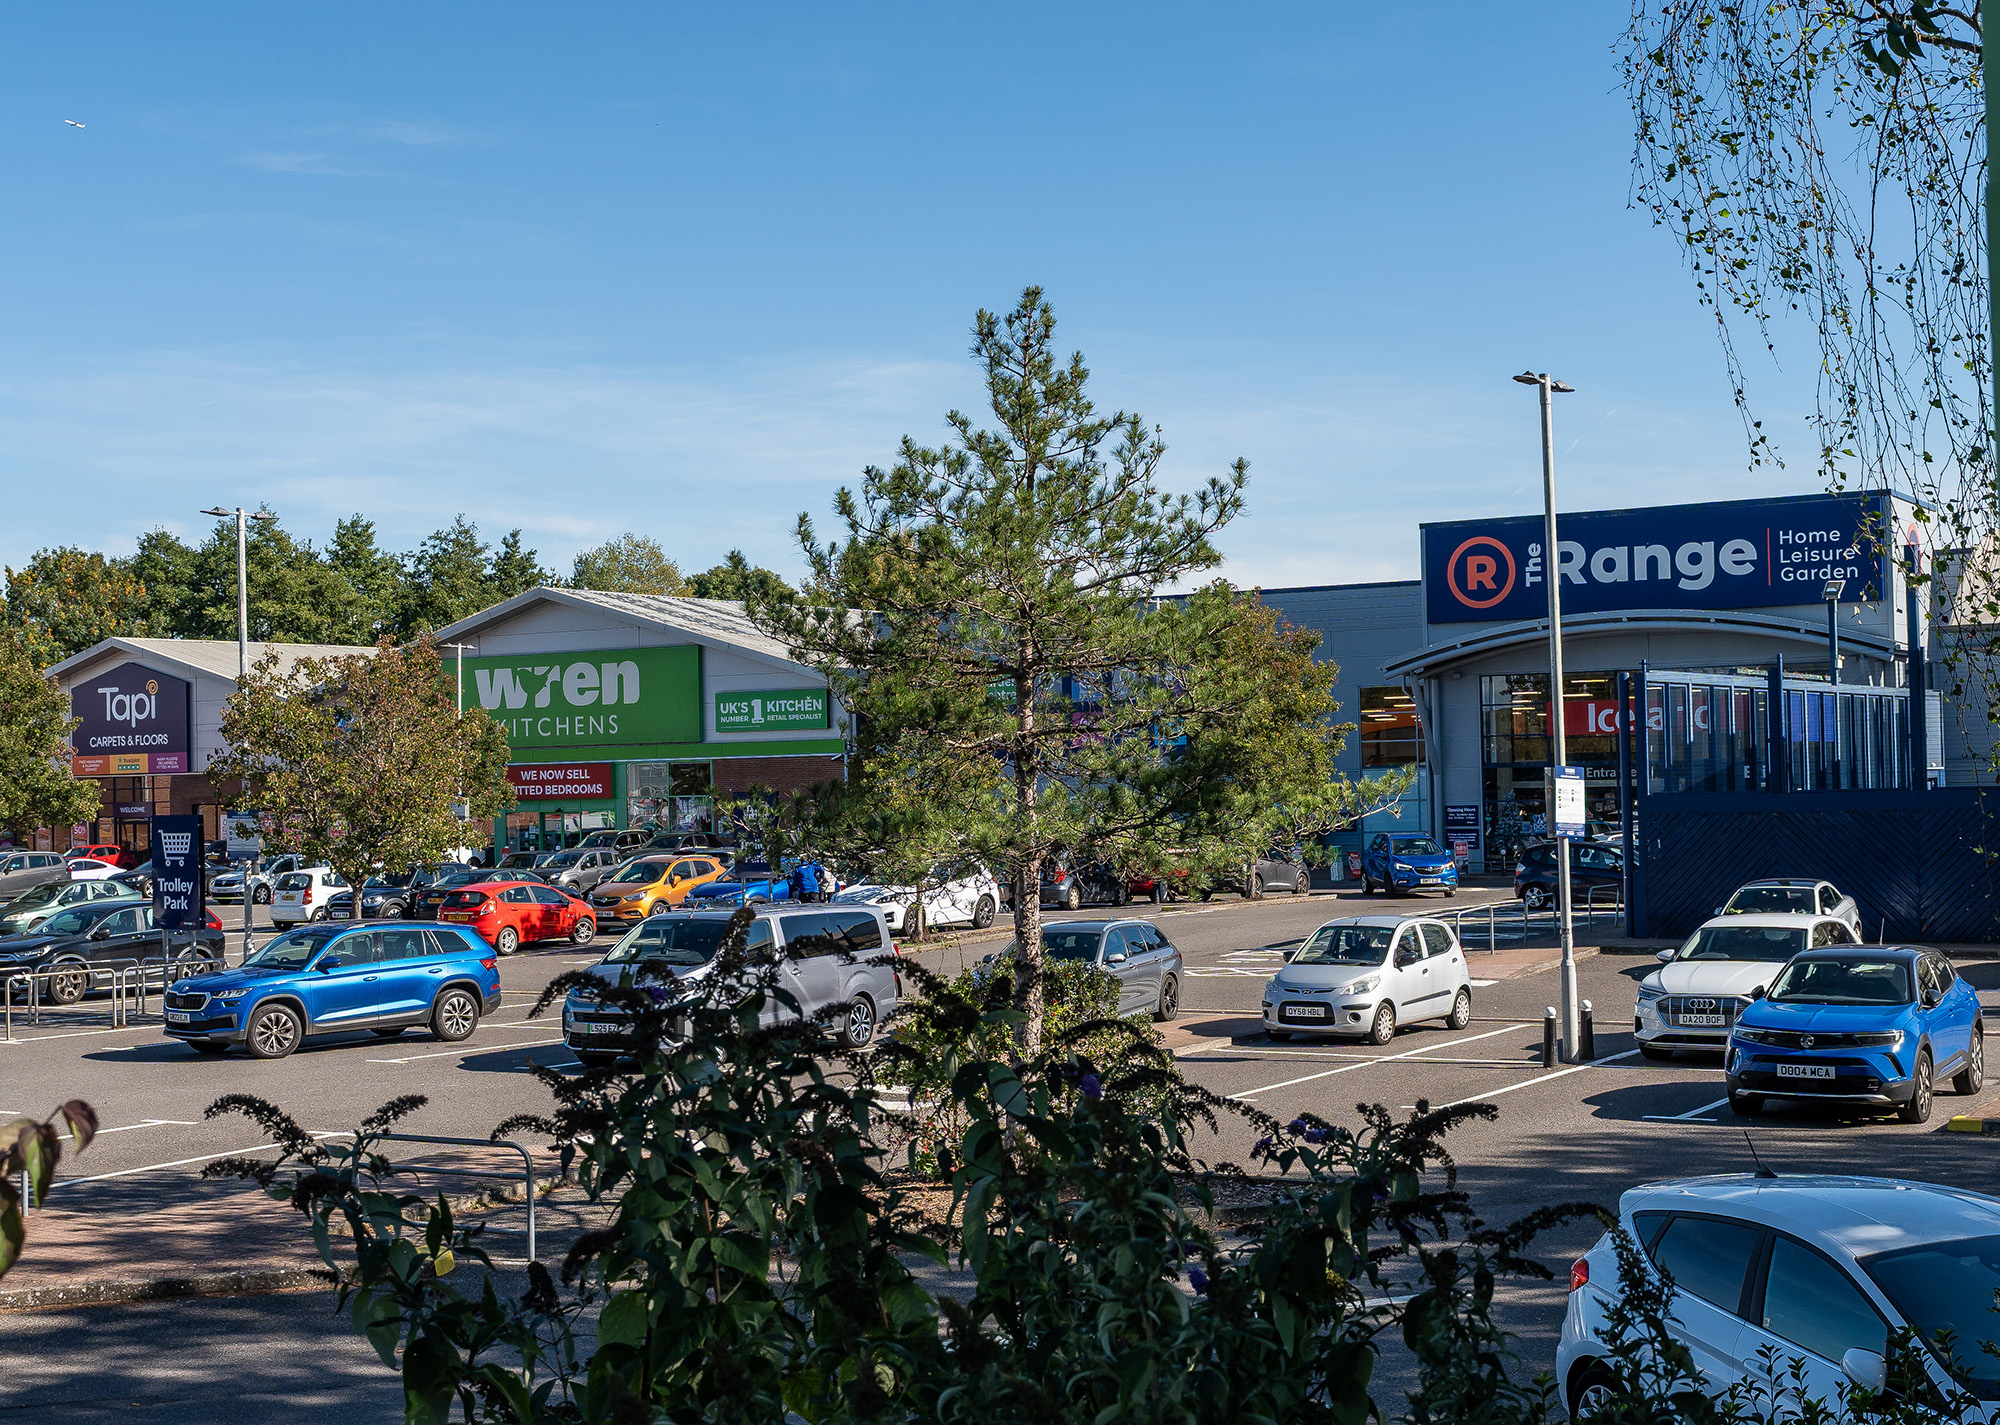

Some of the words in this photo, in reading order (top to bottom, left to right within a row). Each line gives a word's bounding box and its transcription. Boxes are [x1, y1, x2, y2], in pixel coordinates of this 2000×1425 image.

[1779, 530, 1840, 545] Home
[1779, 547, 1856, 564] Leisure
[1526, 542, 1542, 588] The
[1557, 538, 1757, 591] Range
[1466, 555, 1497, 590] R
[1780, 564, 1859, 582] Garden
[474, 660, 641, 710] wren
[98, 680, 158, 728] Tapi
[720, 702, 748, 714] UK'S
[751, 698, 764, 724] 1
[89, 736, 126, 748] CARPETS
[127, 735, 134, 746] &
[135, 733, 168, 746] FLOORS
[520, 771, 538, 780] WE
[540, 770, 564, 780] NOW
[566, 769, 590, 780] SELL
[512, 784, 542, 796] ITTED
[545, 784, 603, 795] BEDROOMS
[156, 878, 194, 895] Trolley
[163, 896, 188, 910] Park
[1288, 1008, 1306, 1016] OY58
[1682, 1015, 1704, 1024] DA20
[1706, 1015, 1722, 1024] BOF
[1810, 1067, 1830, 1077] MCA
